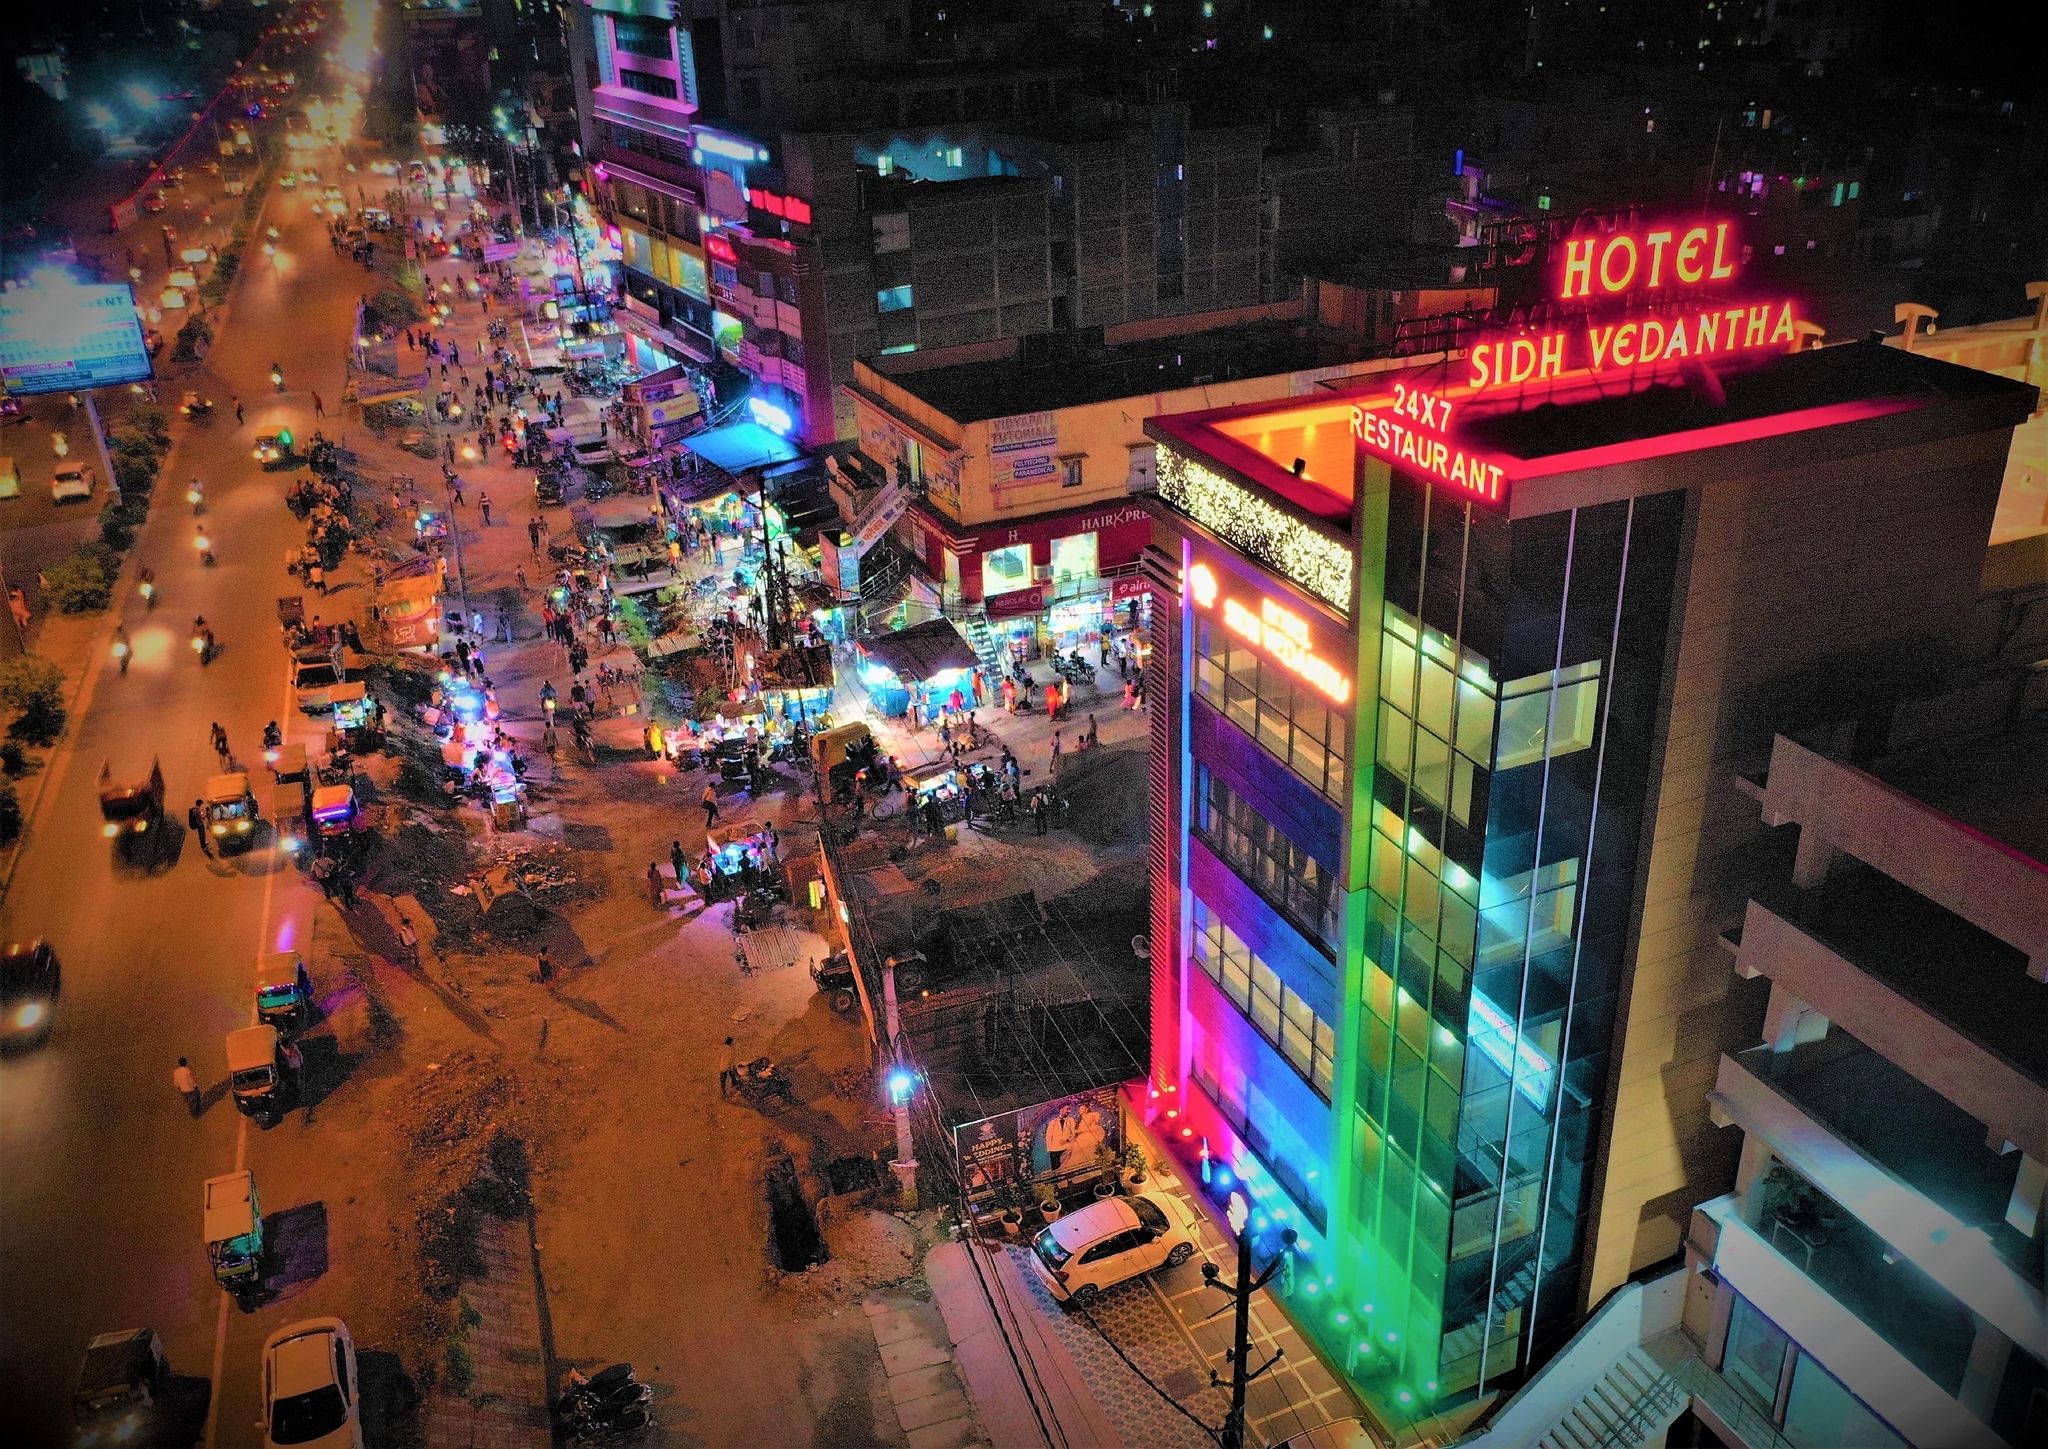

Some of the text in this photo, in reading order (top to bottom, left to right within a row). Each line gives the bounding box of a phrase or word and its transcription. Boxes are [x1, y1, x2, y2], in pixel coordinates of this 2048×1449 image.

[1561, 224, 1732, 297] HOTEL
[1470, 302, 1794, 388] SIDH VEDANTHA
[1393, 383, 1452, 432] 24X7
[1349, 406, 1503, 500] RESTAURANT
[971, 1138, 1003, 1152] HAPPY
